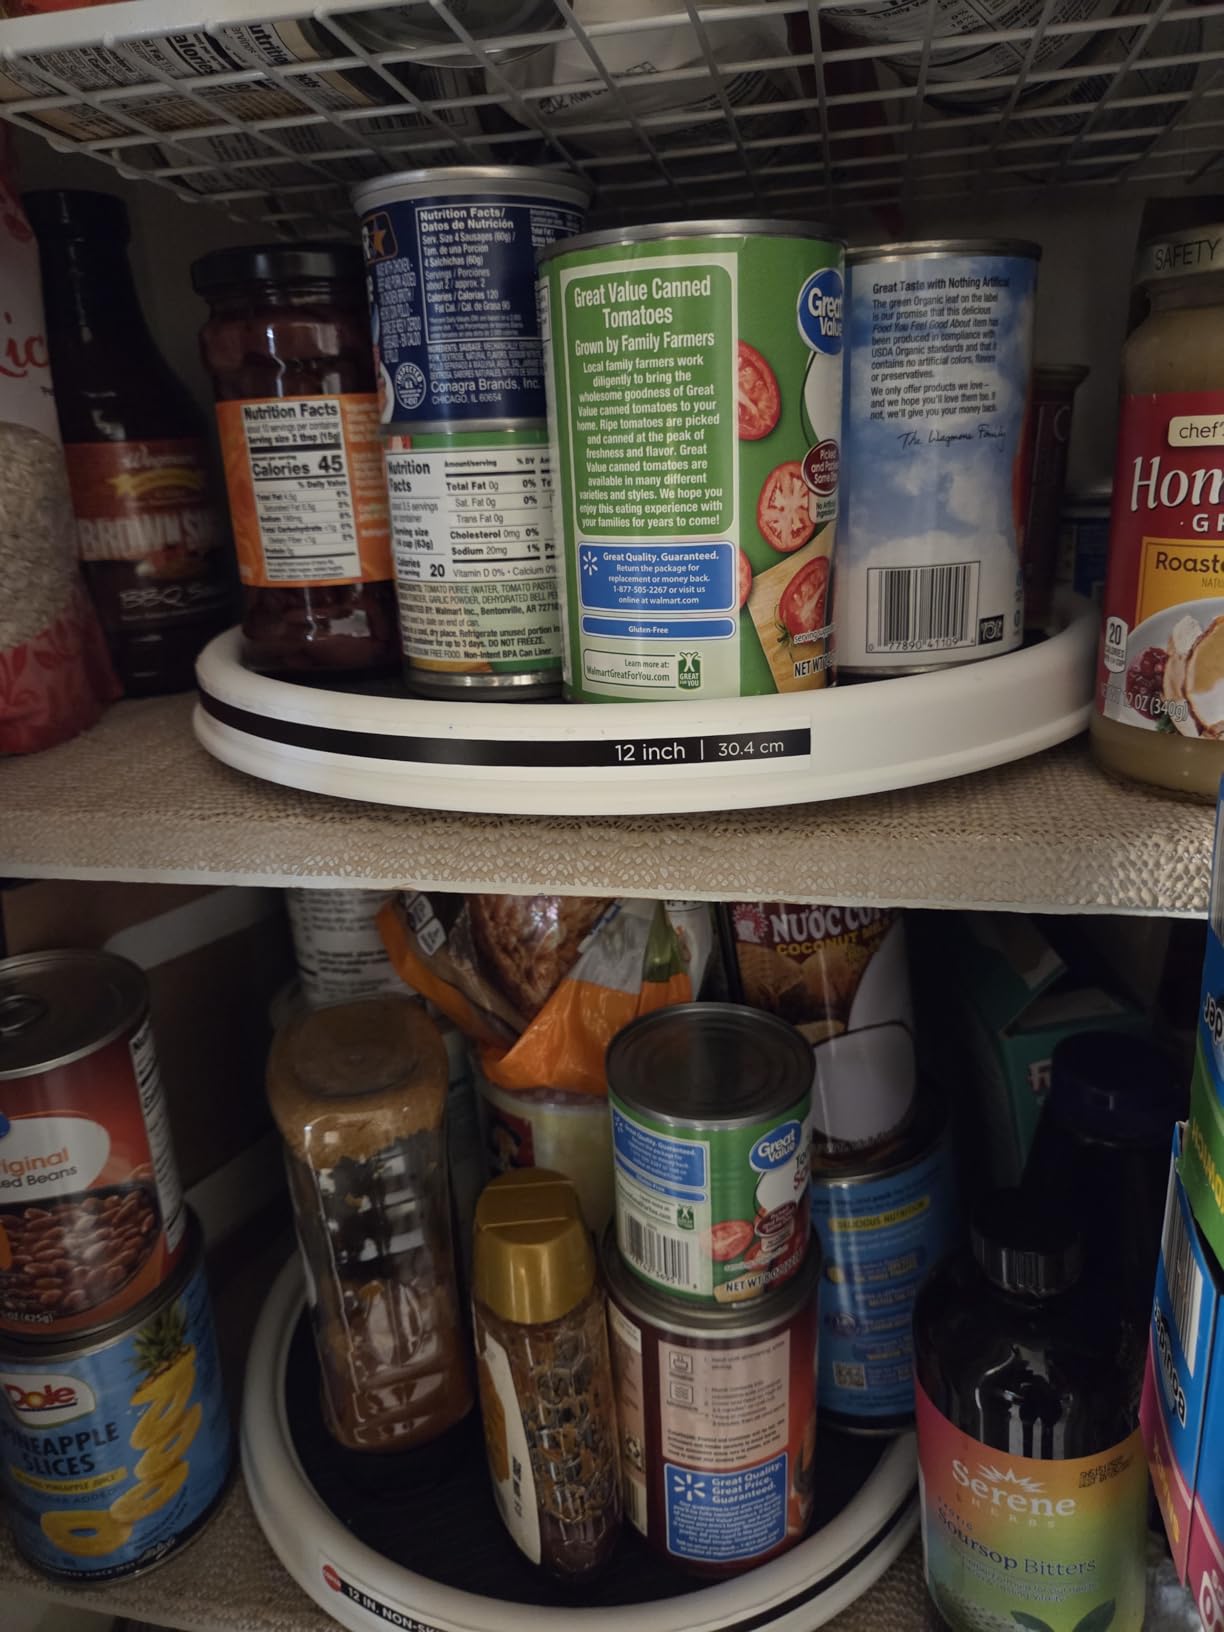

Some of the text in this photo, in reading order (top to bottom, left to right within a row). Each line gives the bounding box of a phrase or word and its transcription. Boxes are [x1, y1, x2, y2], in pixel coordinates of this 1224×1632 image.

[420, 208, 505, 221] Nutrition Facts/
[422, 219, 514, 232] Datos de Nutrición
[1155, 238, 1222, 271] SAFETY
[574, 274, 711, 308] Great Value Canned
[873, 282, 898, 295] Great
[901, 280, 925, 292] Taste
[927, 279, 946, 289] with
[948, 278, 981, 289] Nothing
[603, 305, 673, 328] Tomatoes
[575, 331, 715, 356] Grown by Family Farmers
[583, 354, 704, 373] Local family farmers work
[431, 377, 541, 394] Conagra Brands, Inc.
[593, 370, 692, 388] diligently to bring the
[579, 384, 714, 403] wholesome goodness of Great
[244, 403, 338, 421] Nutrition Facts
[578, 401, 717, 417] Value canned tomatoes to your
[577, 413, 720, 432] home. Ripe tomatoes are picked
[587, 429, 705, 446] and canned at the peak of
[586, 444, 707, 459] freshness and flavor. Great
[253, 455, 344, 477] Calories 45
[387, 460, 431, 475] Nutrition
[586, 459, 708, 473] Value canned tomatoes are
[446, 479, 536, 492] Total Fat 0g 0%
[588, 472, 707, 487] available in many different
[472, 497, 484, 507] Fat
[486, 497, 496, 508] 0g
[523, 496, 538, 505] 0%
[582, 514, 720, 529] your families for years to come!
[450, 528, 539, 540] Cholesterol 0mg 0%
[451, 544, 540, 556] Sodium 20mg 1%
[603, 551, 720, 563] Great Quality. Guaranteed.
[430, 564, 445, 578] 20
[452, 566, 544, 578] Vitamin D 0% Calcium
[617, 564, 700, 573] Return the package for
[608, 574, 711, 584] replacement or money back.
[119, 585, 189, 608] BBQ
[613, 586, 668, 594] 1-877-505-2267
[679, 585, 695, 594] visit
[628, 625, 669, 634] Gluten-Free
[1109, 623, 1122, 646] 20
[625, 659, 641, 668] Learn
[662, 660, 670, 669] at:
[795, 661, 810, 677] NET
[587, 665, 670, 682] WalmartGreatForYou.com
[679, 672, 699, 681] GREAT
[1150, 698, 1188, 722] (340g)
[615, 741, 784, 761] 12 inch 30.4 cm
[758, 1128, 795, 1157] Great
[28, 1165, 78, 1186] Beans
[726, 1281, 744, 1291] NET
[3, 1383, 78, 1407] Dole
[24, 1453, 95, 1477] SLICES
[712, 1462, 783, 1486] Great Quality.
[712, 1485, 742, 1494] Great
[712, 1481, 776, 1504] Guaranteed.
[952, 1459, 1077, 1518] Serene
[1023, 1558, 1096, 1577] Bitters
[349, 1587, 360, 1600] 12
[363, 1597, 380, 1614] IN.
